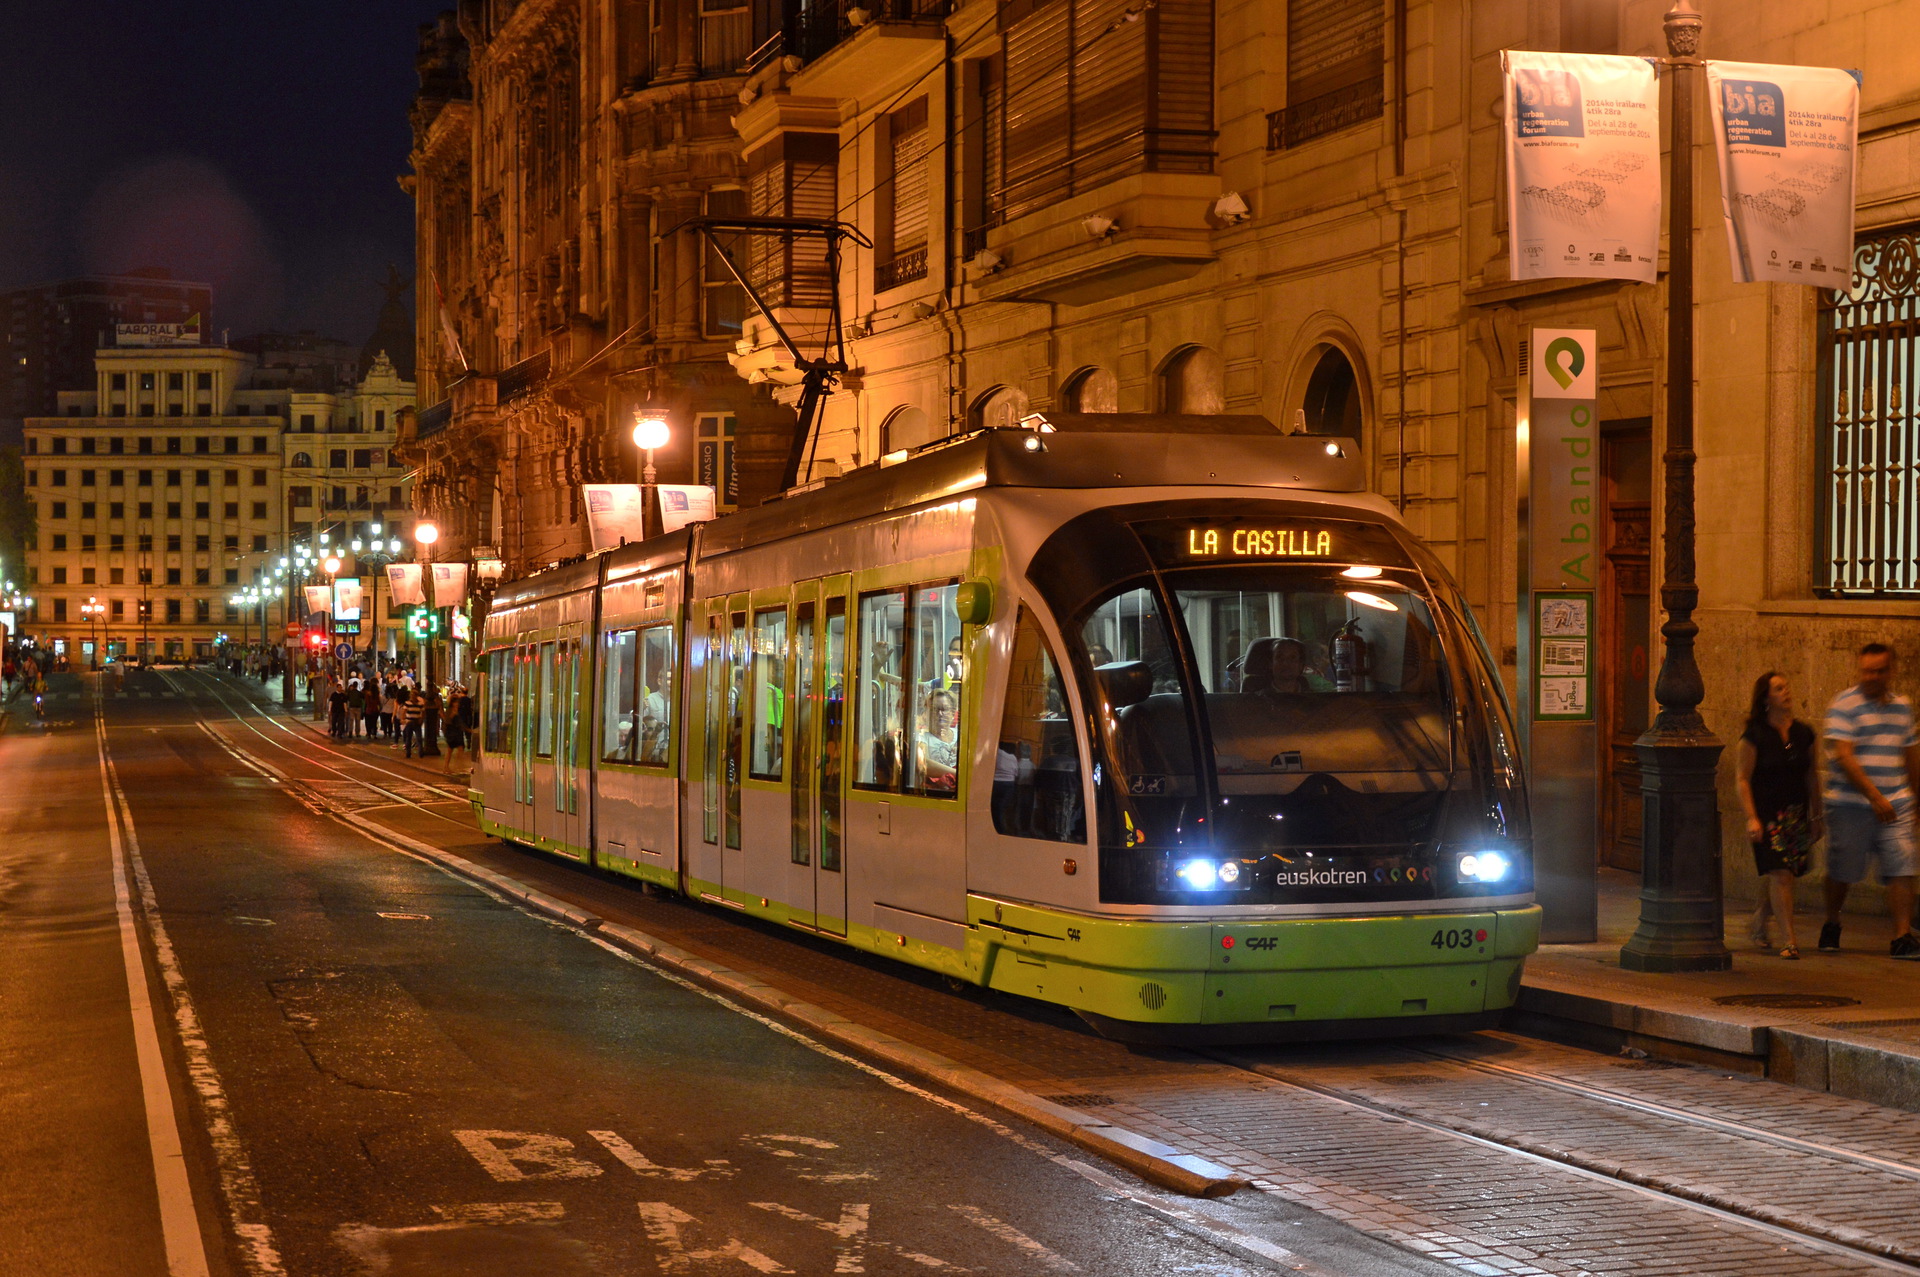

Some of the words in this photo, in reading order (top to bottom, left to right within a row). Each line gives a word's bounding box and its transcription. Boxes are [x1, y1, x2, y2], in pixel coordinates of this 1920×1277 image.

[1520, 72, 1573, 107] bia
[1616, 101, 1646, 109] irailaren
[1725, 83, 1776, 117] bia
[1788, 111, 1815, 119] 2014ko
[1816, 112, 1847, 121] irailaren
[1523, 118, 1570, 128] regeneration
[1588, 120, 1601, 128] Del
[1588, 128, 1626, 137] septiembre
[1636, 130, 1651, 138] 2014
[1728, 126, 1772, 136] regeneration
[1828, 133, 1837, 141] de
[1524, 140, 1579, 148] www.biaforum.org
[1790, 140, 1827, 149] septiembre
[1836, 144, 1850, 152] 2014
[1730, 148, 1781, 158] www.biaforum.org
[118, 325, 172, 335] LABORAL
[1561, 405, 1591, 584] Abando
[1190, 530, 1218, 554] LA
[1232, 530, 1330, 556] CASILLA
[1276, 868, 1366, 890] euskotren
[1068, 928, 1081, 942] CAF
[1430, 928, 1473, 950] 403
[1246, 937, 1278, 951] CAF
